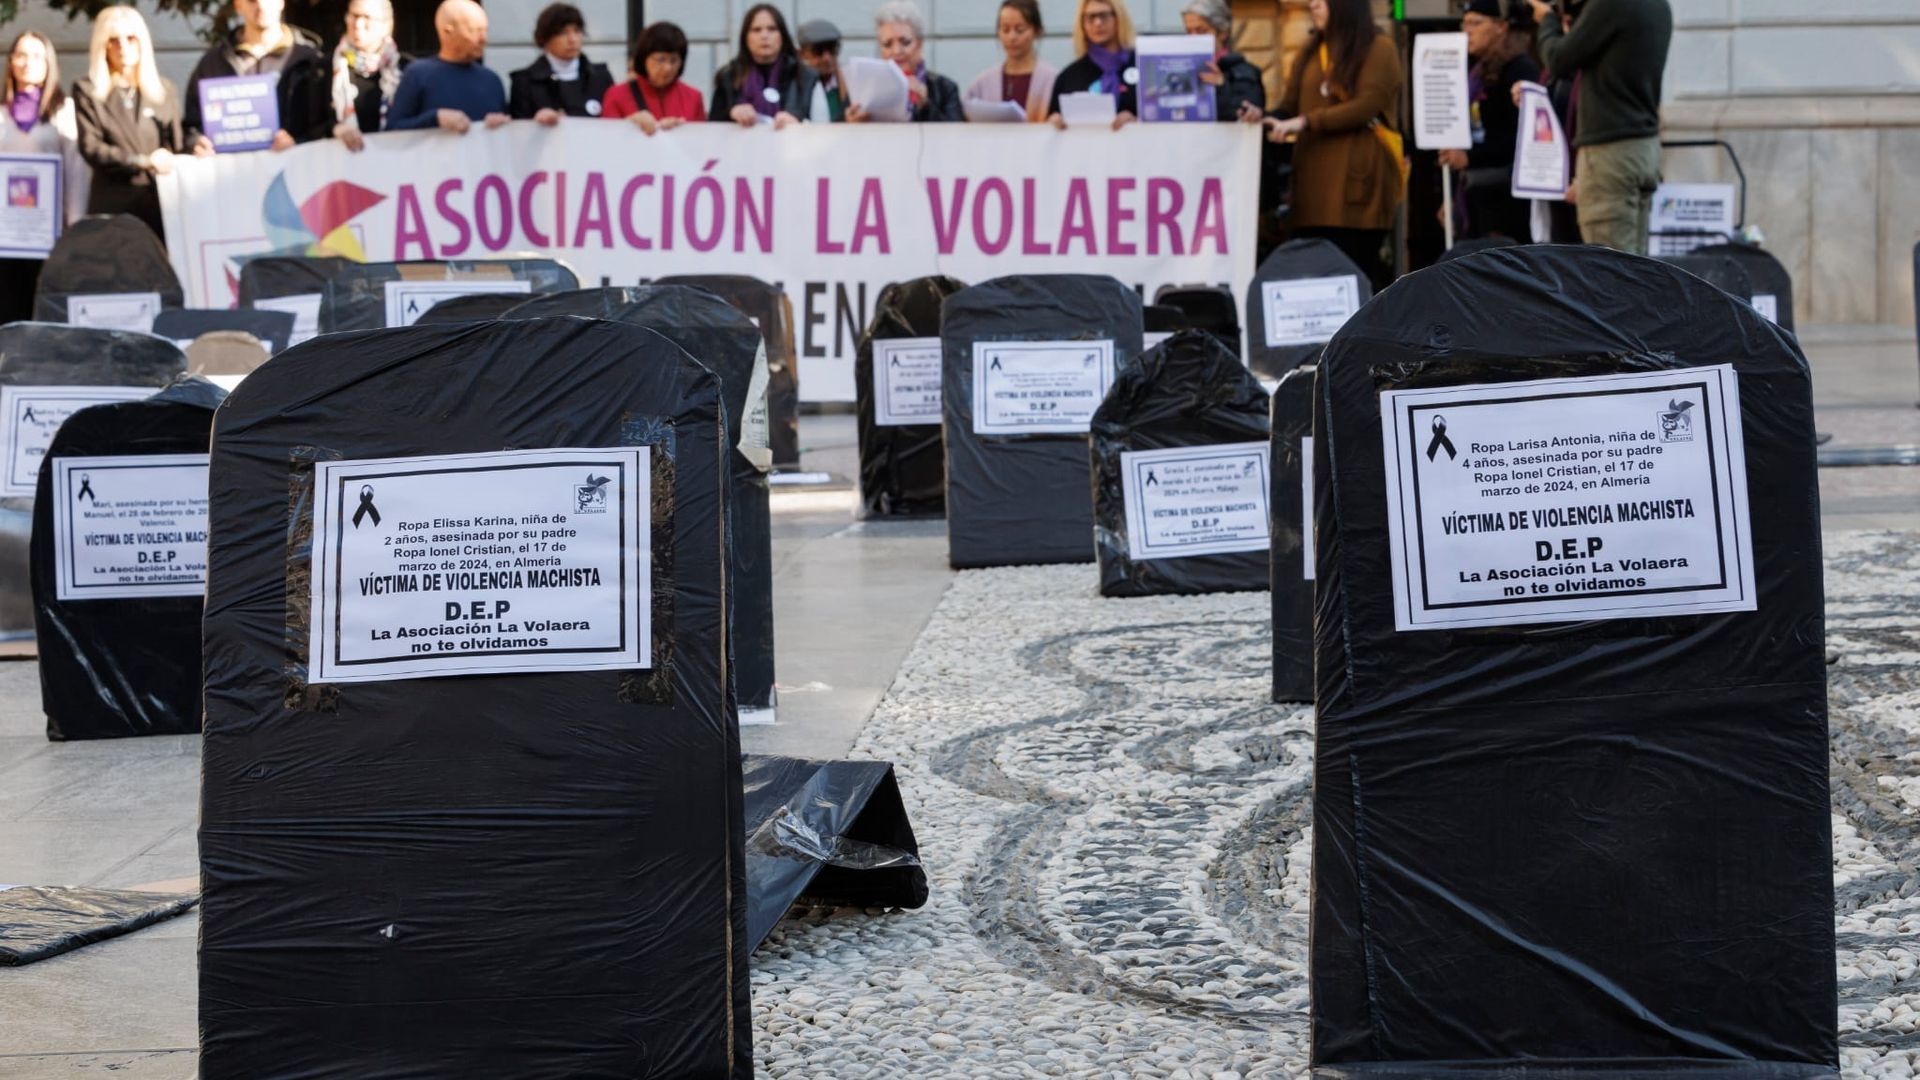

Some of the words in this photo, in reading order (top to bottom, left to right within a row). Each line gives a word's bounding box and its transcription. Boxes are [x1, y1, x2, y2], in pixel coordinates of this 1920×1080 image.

[394, 159, 774, 262] ASOCIACIÓN
[816, 177, 891, 254] LA
[926, 177, 1229, 255] VOLAERA
[1471, 443, 1504, 454] Ropa
[1508, 439, 1548, 451] Larisa
[1551, 435, 1604, 448] Antonia,
[1609, 431, 1636, 442] niña
[1640, 430, 1656, 440] de
[1462, 459, 1470, 469] 4
[1474, 456, 1508, 468] años,
[1513, 450, 1577, 466] asesinada
[1582, 450, 1603, 462] por
[1607, 448, 1622, 457] su
[1627, 444, 1663, 457] padre
[1474, 470, 1508, 483] Ropa
[1547, 464, 1601, 477] Cristian,
[1605, 462, 1615, 473] el
[1620, 461, 1634, 471] 17
[1638, 459, 1654, 470] de
[1481, 487, 1520, 497] marzo
[1524, 484, 1540, 494] de
[1544, 480, 1578, 492] 2024,
[1582, 480, 1597, 489] en
[1601, 475, 1650, 488] Almería
[399, 521, 429, 532] Ropa
[434, 518, 470, 528] Elissa
[475, 516, 518, 527] Karina,
[522, 515, 548, 525] niña
[552, 514, 566, 524] de
[1442, 511, 1505, 535] VÍCTIMA
[1509, 511, 1529, 530] DE
[1532, 504, 1614, 529] VIOLENCIA
[1617, 499, 1695, 522] MACHISTA
[123, 534, 135, 545] DE
[137, 532, 183, 544] VIOLENCIA
[385, 537, 391, 545] 2
[395, 534, 428, 545] años,
[432, 530, 494, 543] asesinada
[498, 530, 519, 542] por
[523, 530, 537, 539] su
[542, 527, 576, 540] padre
[138, 551, 176, 563] D.E.P
[394, 547, 425, 559] Ropa
[464, 544, 515, 555] Cristian,
[519, 543, 529, 553] el
[534, 543, 547, 552] 17
[552, 542, 566, 552] de
[1536, 537, 1603, 561] D.E.P
[399, 562, 436, 572] marzo
[441, 560, 455, 570] de
[459, 559, 491, 570] 2024,
[514, 557, 561, 568] Almería
[1460, 571, 1481, 583] La
[1487, 563, 1585, 581] Asociación
[1592, 561, 1614, 574] La
[1619, 558, 1688, 572] Volaera
[360, 573, 418, 596] VÍCTIMA
[423, 574, 441, 591] DE
[446, 570, 523, 590] VIOLENCIA
[528, 568, 601, 588] MACHISTA
[1504, 585, 1525, 596] no
[1531, 582, 1549, 594] te
[1555, 576, 1646, 592] olvidamos
[445, 601, 510, 621] D.E.P
[372, 629, 391, 641] La
[397, 623, 491, 639] Asociación
[498, 622, 518, 633] La
[525, 621, 590, 631] Volaera
[412, 642, 432, 653] no
[438, 640, 455, 651] te
[461, 636, 548, 650] olvidamos
